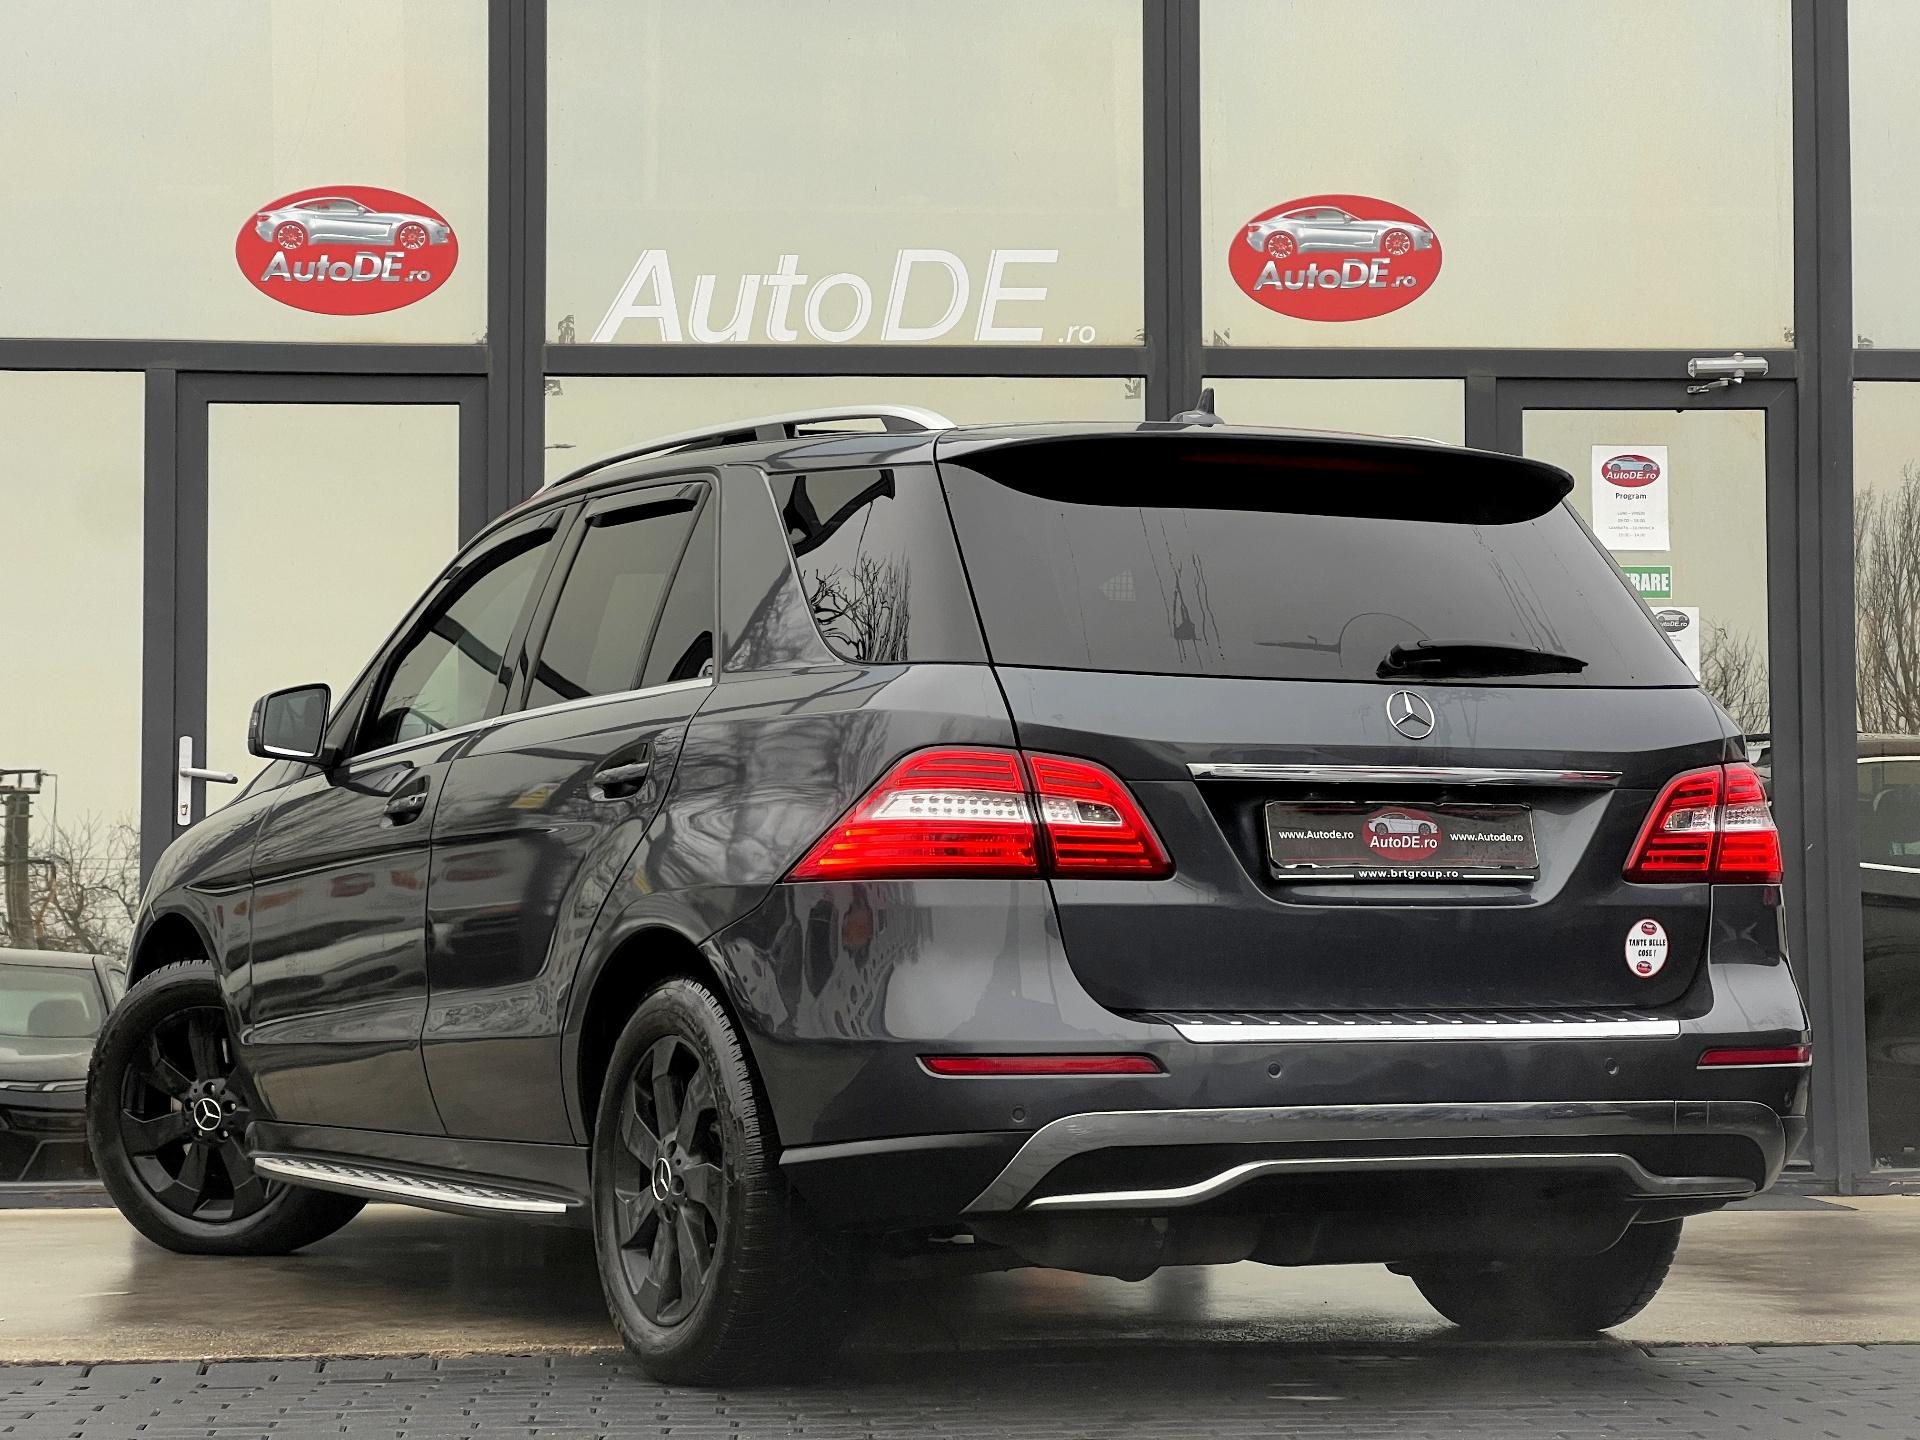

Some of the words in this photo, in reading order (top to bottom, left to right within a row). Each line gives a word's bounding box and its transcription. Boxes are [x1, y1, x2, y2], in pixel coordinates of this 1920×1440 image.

[1606, 471, 1656, 479] AutoDE.ro
[1615, 492, 1647, 500] Program
[1625, 573, 1669, 591] RARE
[1278, 829, 1354, 839] www.Autode.ro
[1449, 832, 1524, 842] www.Autode.ro
[1369, 835, 1438, 849] AutoDE.ro
[1358, 869, 1459, 879] www.brtgroup.ro
[1638, 949, 1652, 957] COSE
